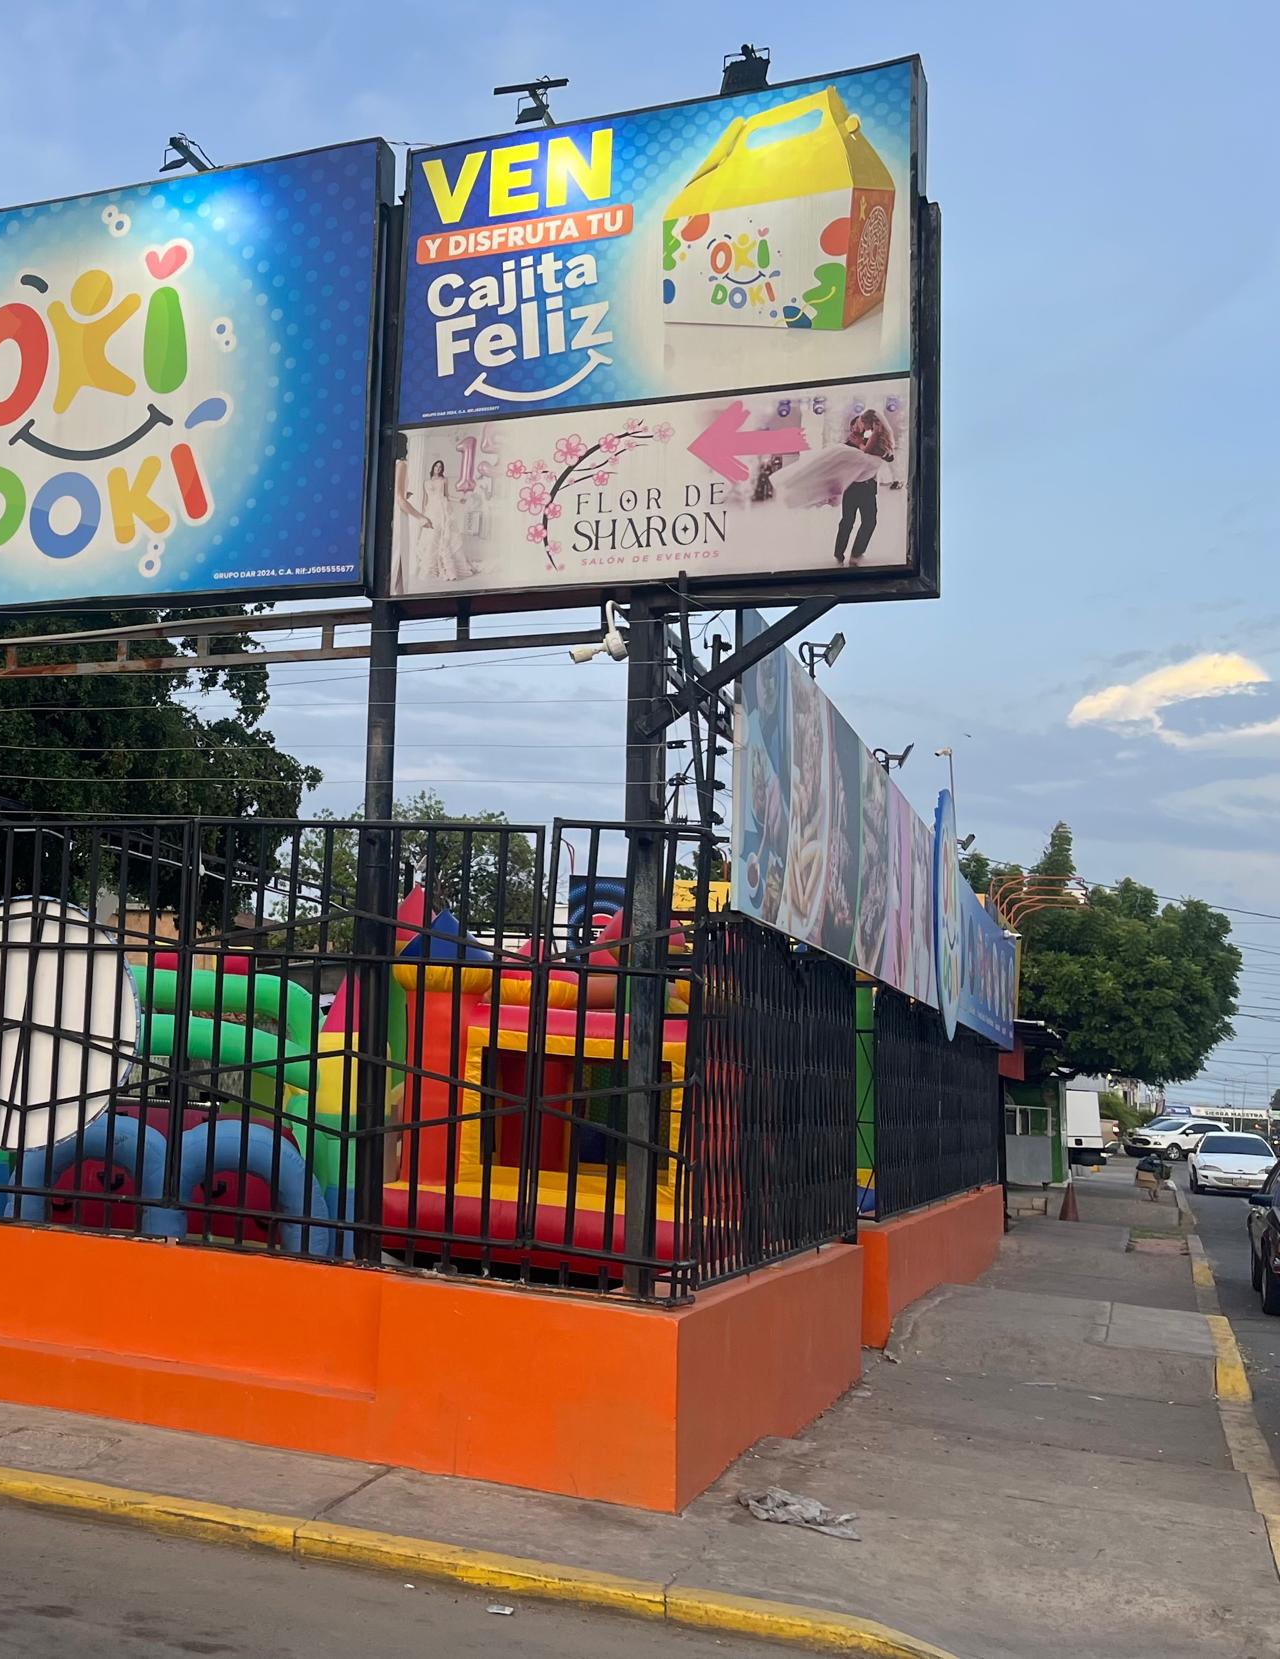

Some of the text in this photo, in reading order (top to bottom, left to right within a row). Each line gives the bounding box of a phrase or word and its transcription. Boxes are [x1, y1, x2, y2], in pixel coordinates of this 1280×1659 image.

[421, 128, 613, 224] VEN
[425, 210, 624, 258] Y DISFRUTA TU
[427, 252, 598, 317] Cajita
[711, 282, 776, 309] DOKI
[436, 295, 614, 377] Feliz
[576, 482, 725, 515] FLOR DE
[572, 511, 727, 552] SHARON
[213, 571, 239, 580] GRUPO
[240, 570, 256, 578] DAR
[278, 568, 293, 576] C.A.
[632, 554, 649, 563] DE
[656, 550, 720, 561] EVENTOS
